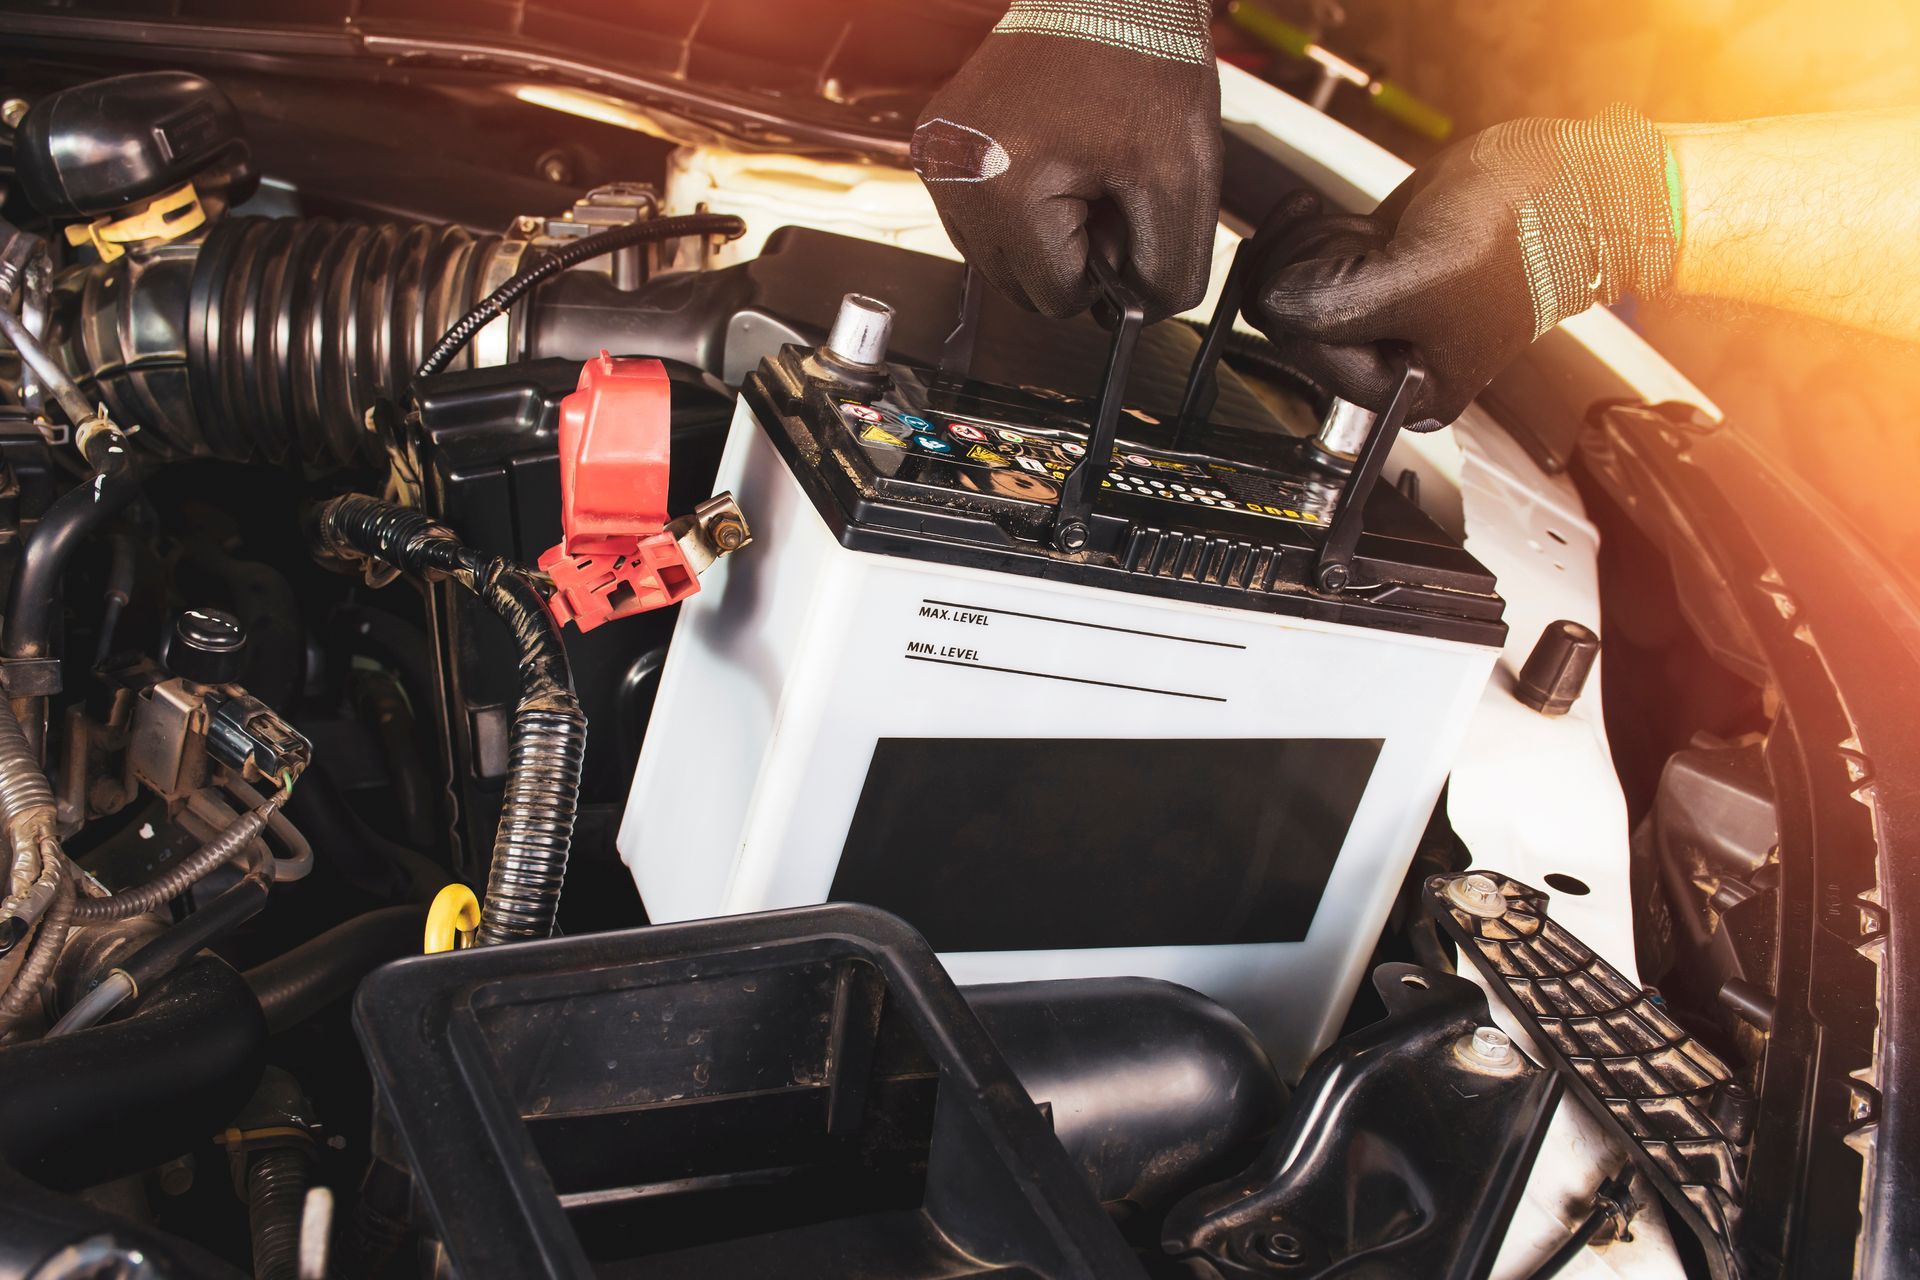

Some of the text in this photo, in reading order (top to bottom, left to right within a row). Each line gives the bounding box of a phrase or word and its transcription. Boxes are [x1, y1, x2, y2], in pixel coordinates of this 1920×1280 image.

[918, 606, 989, 626] MAX. LEVEL
[906, 641, 979, 661] MIN. LEVEL
